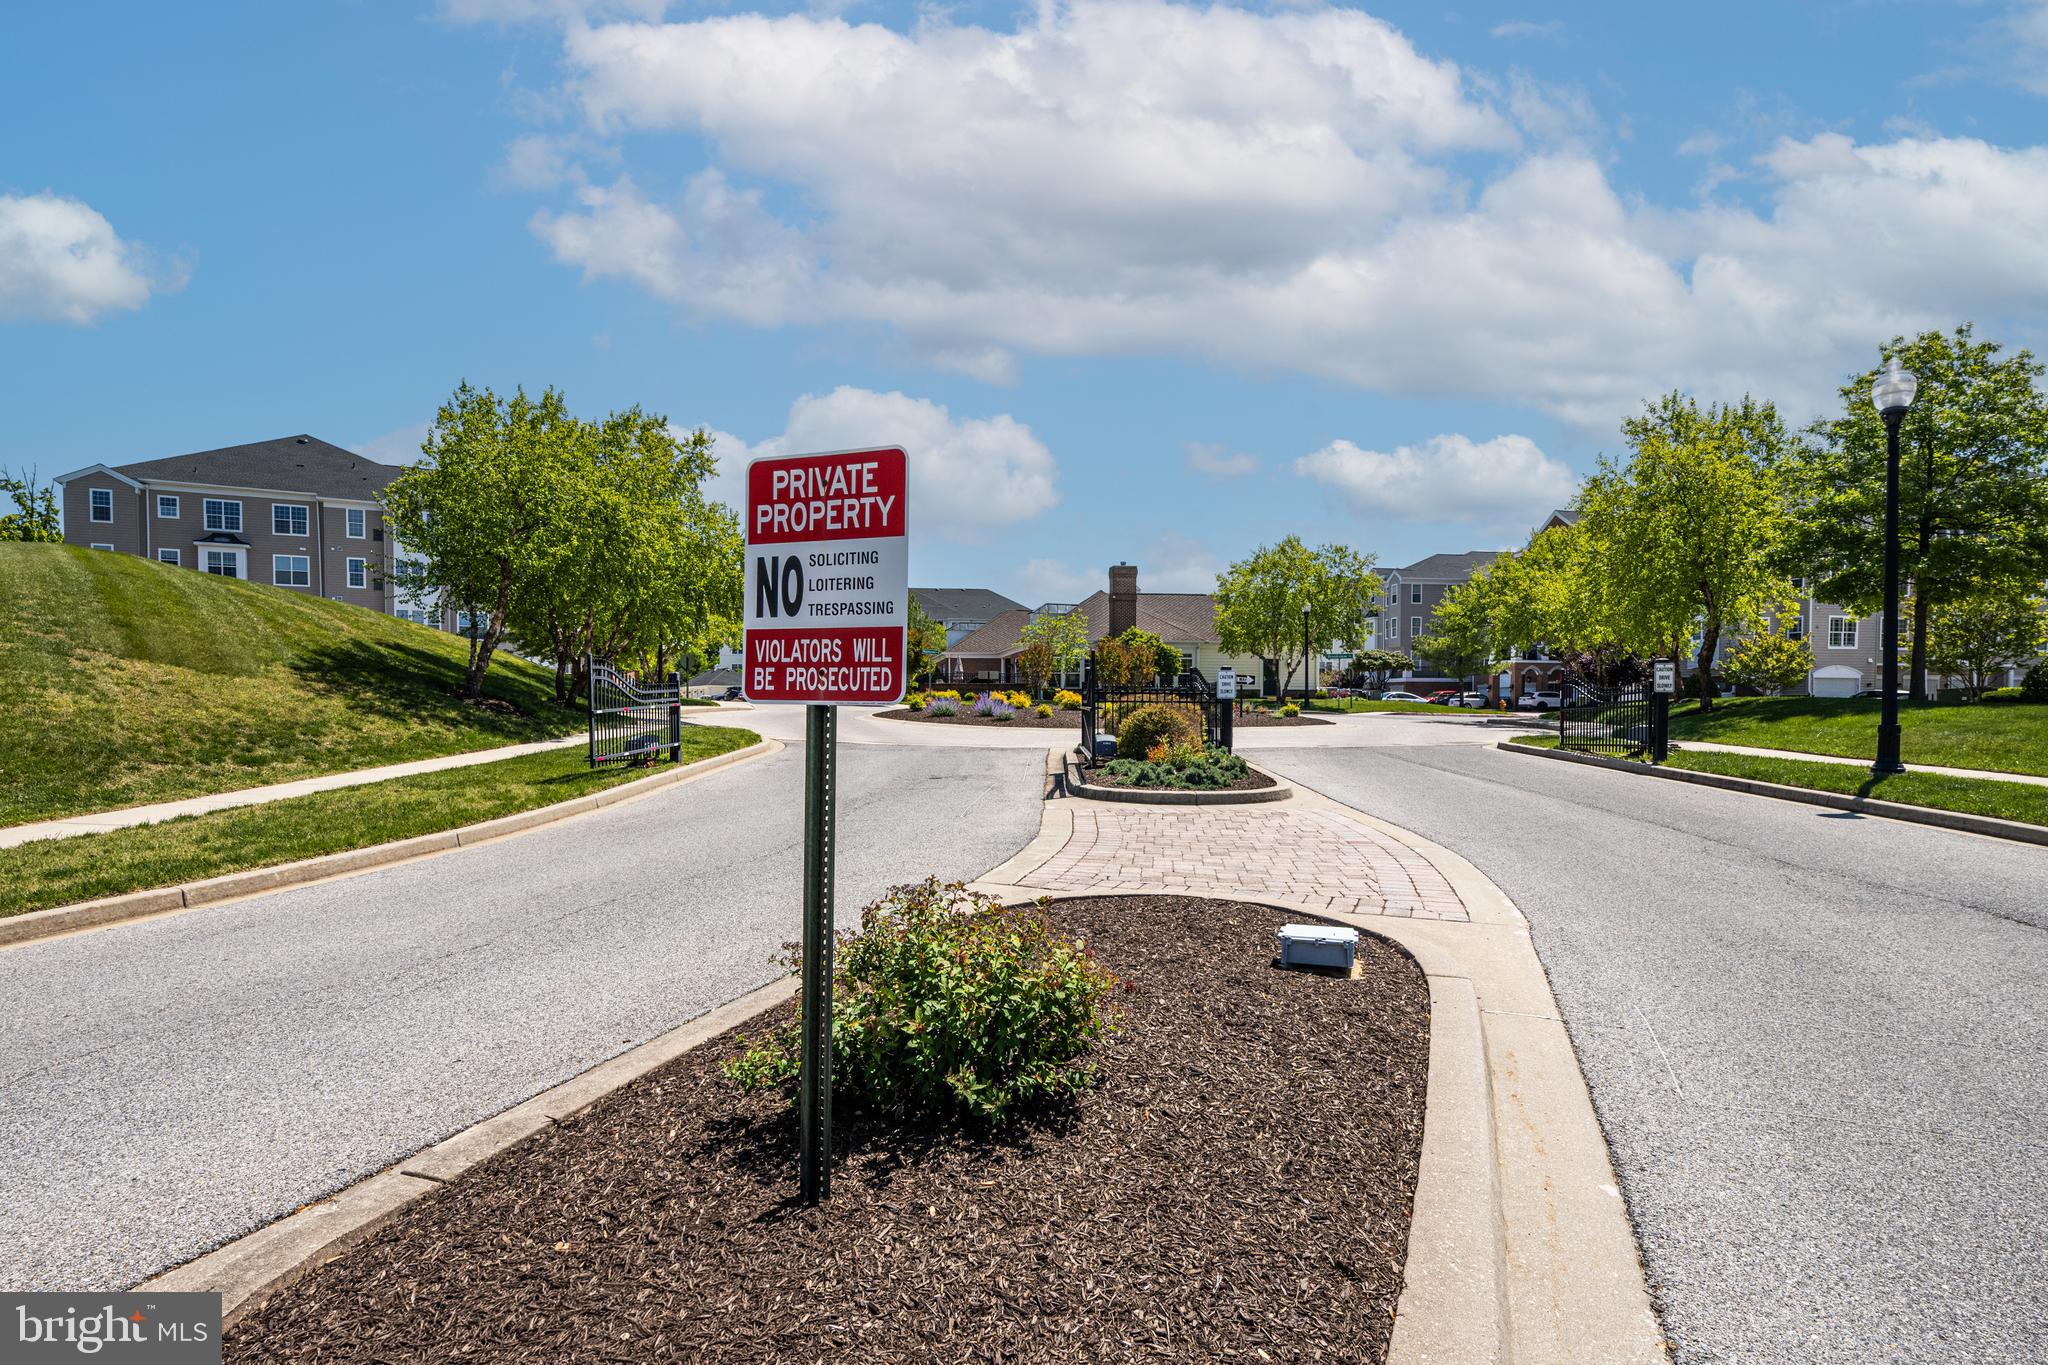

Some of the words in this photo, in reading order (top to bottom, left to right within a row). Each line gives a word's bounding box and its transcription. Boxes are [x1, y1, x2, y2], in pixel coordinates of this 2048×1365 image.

[772, 462, 879, 500] PRIVATE
[756, 495, 896, 534] PROPERTY
[808, 550, 879, 567] SOLICITING
[756, 555, 804, 618] NO
[808, 576, 874, 592] LOITERING
[808, 601, 894, 616] TRESPASSING
[755, 638, 842, 663] VIOLATORS
[853, 638, 892, 662] WILL
[754, 667, 774, 690] BE
[785, 667, 892, 691] PROSECUTED
